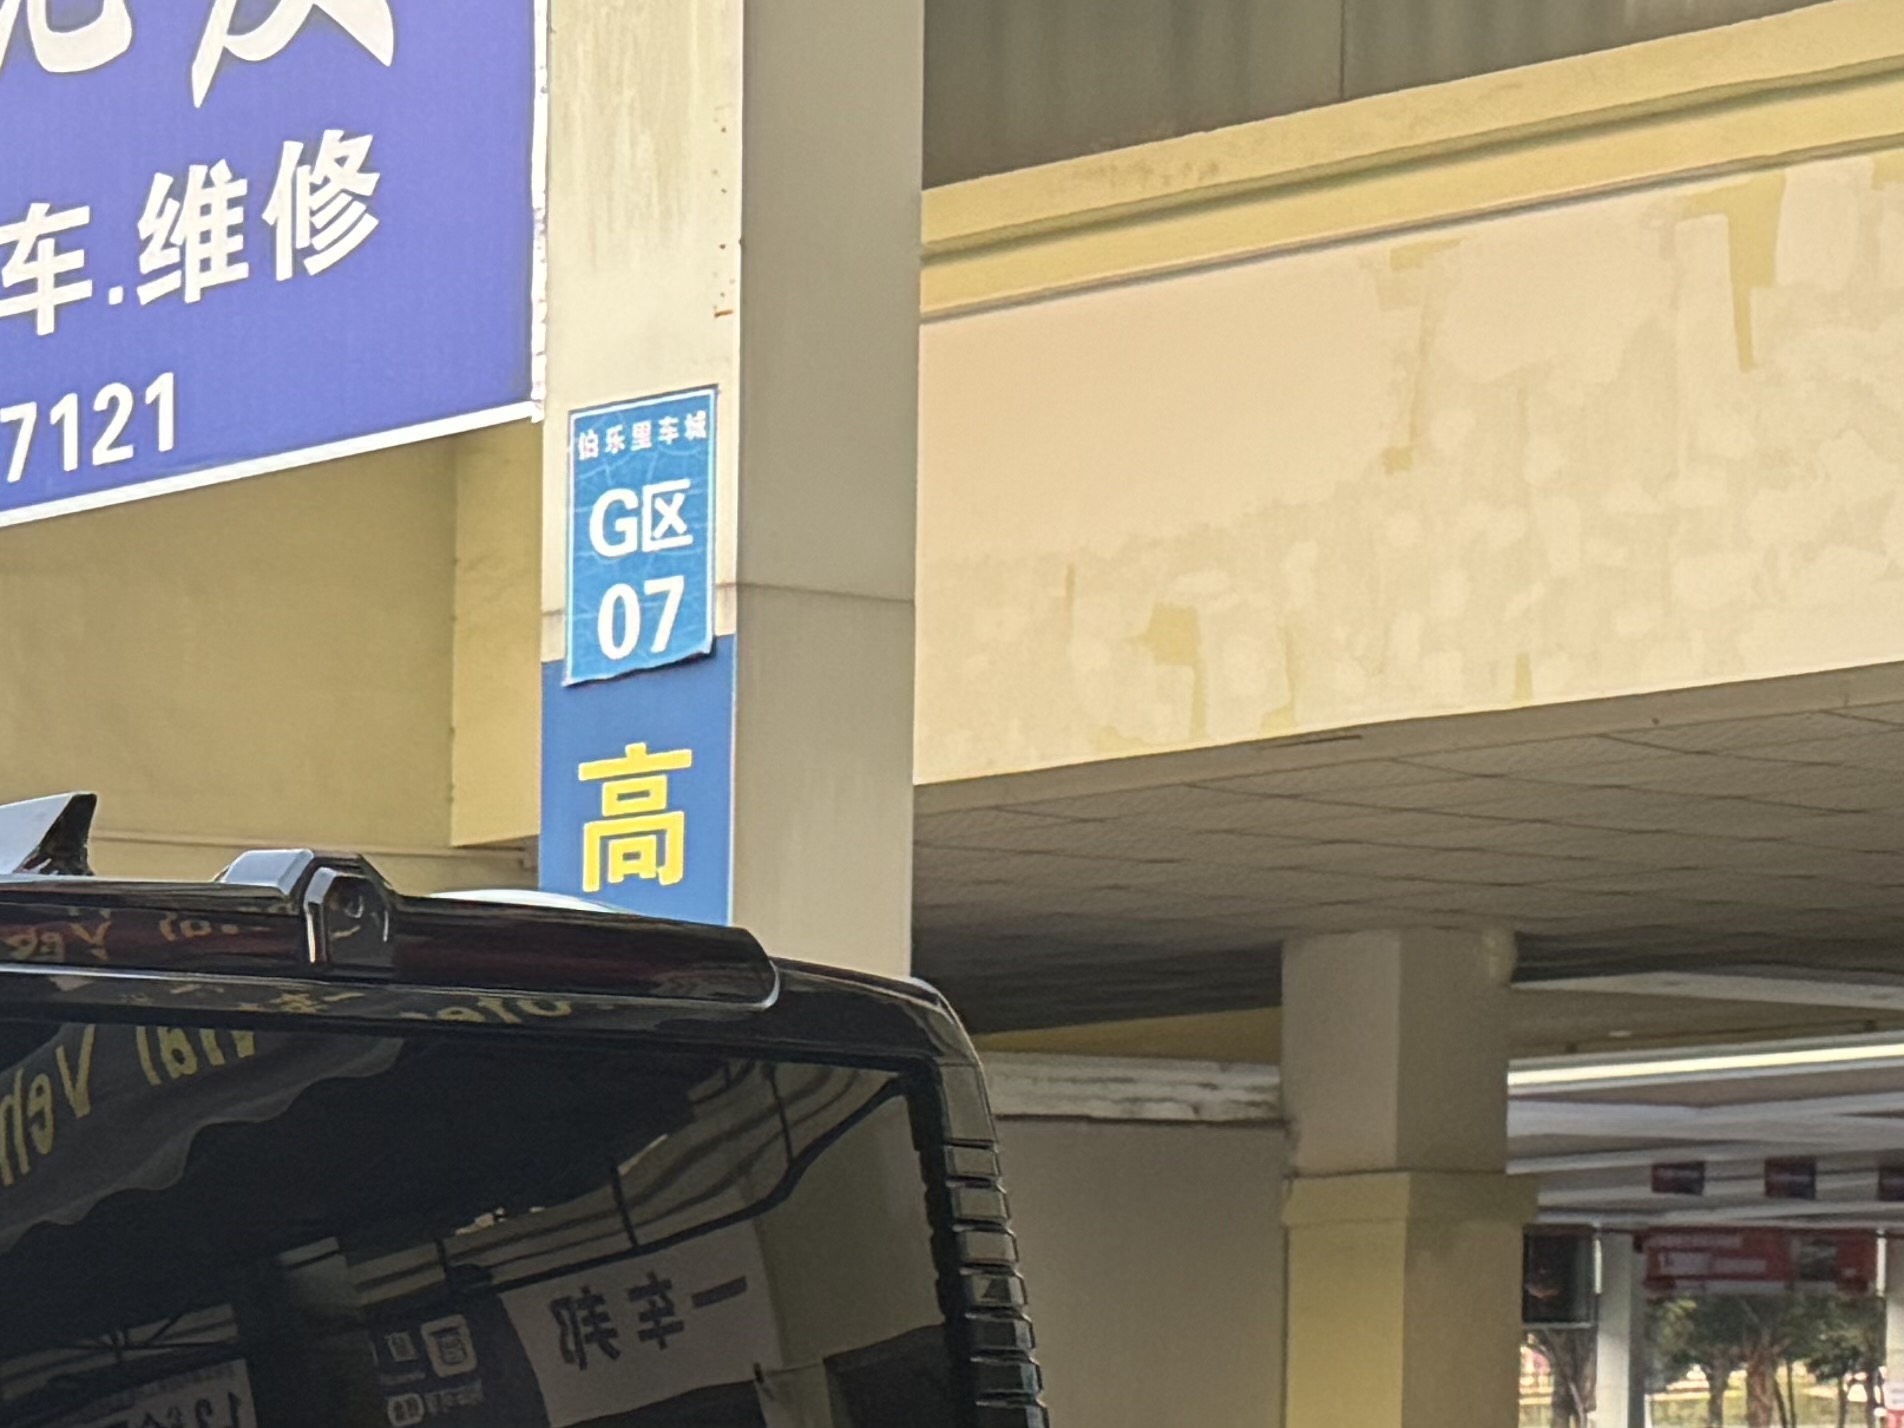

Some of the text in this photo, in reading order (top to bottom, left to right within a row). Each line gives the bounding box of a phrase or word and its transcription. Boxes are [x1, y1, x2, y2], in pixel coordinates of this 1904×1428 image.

[0, 370, 179, 482] 7121
[589, 478, 694, 558] G区
[597, 575, 685, 660] 07
[579, 742, 693, 894] 高
